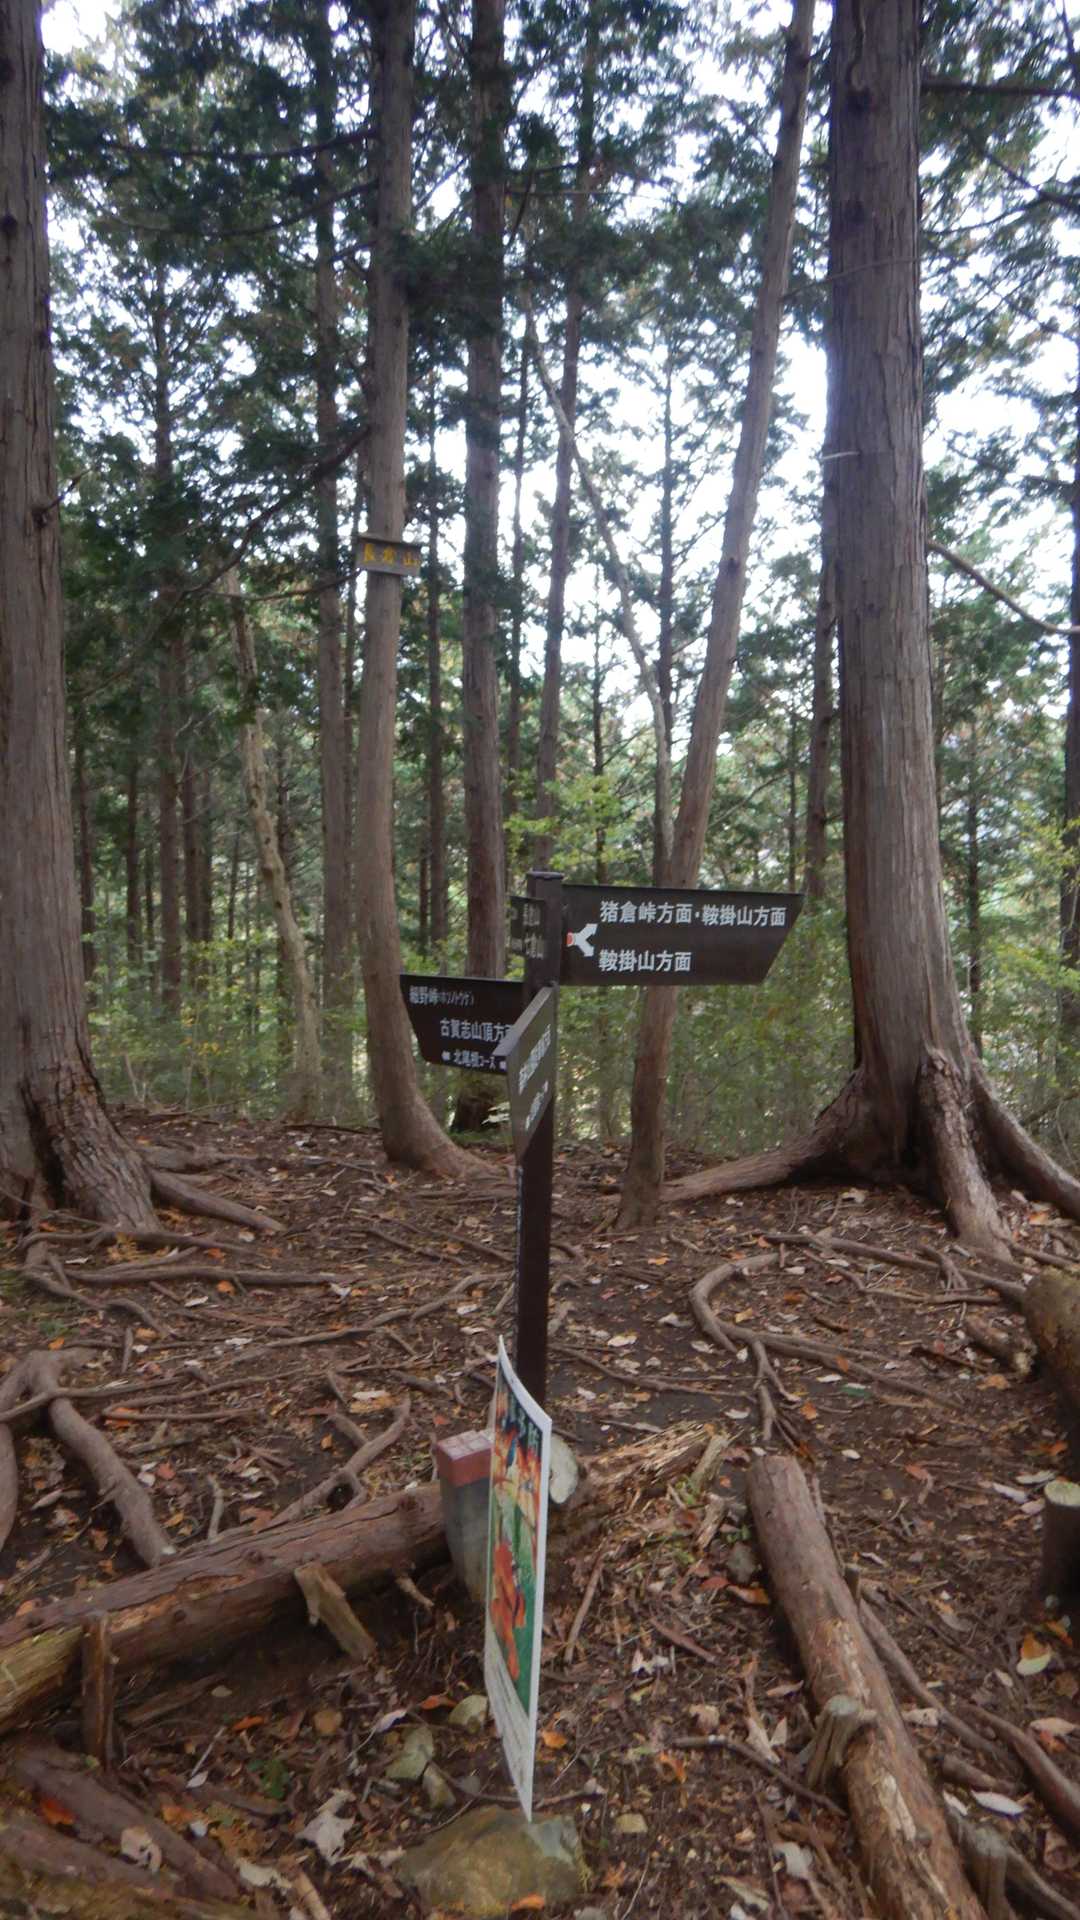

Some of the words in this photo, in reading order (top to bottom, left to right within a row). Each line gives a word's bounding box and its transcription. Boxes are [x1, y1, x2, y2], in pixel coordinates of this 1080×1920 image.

[598, 949, 692, 972] 鞍掛山方面
